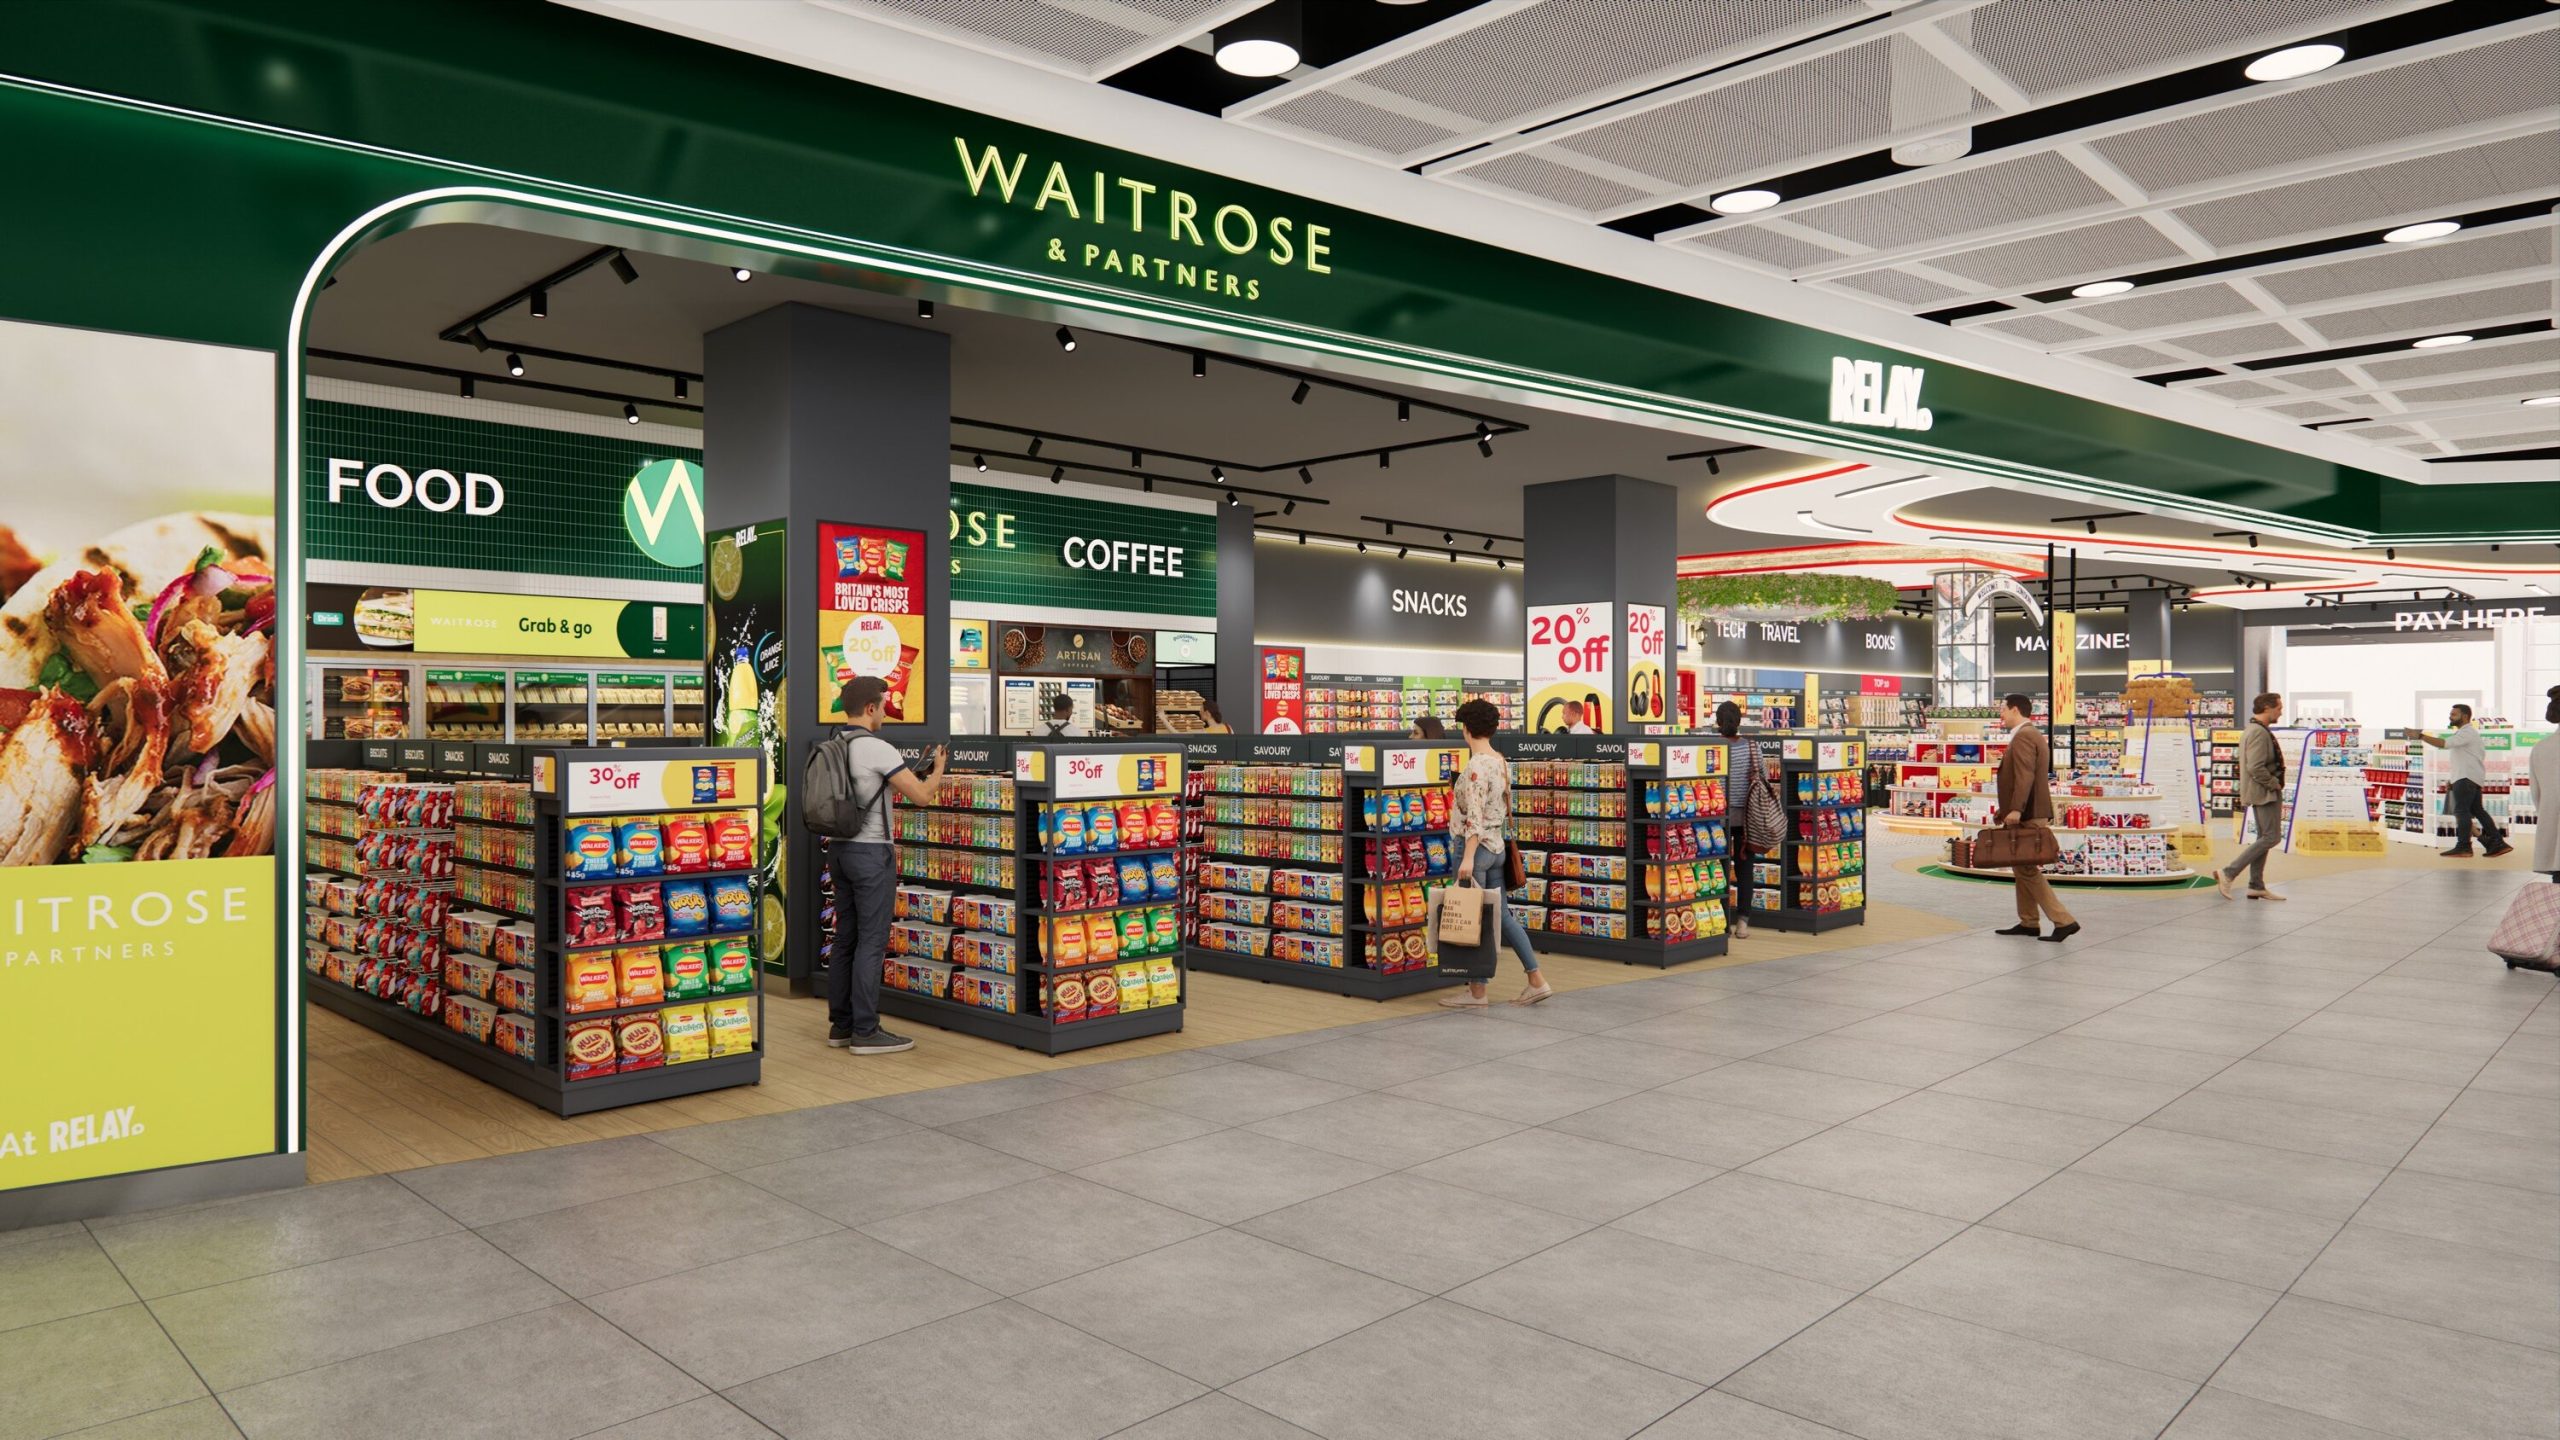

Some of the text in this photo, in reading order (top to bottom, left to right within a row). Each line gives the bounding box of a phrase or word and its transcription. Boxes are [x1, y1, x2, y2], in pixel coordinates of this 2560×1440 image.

[954, 136, 1331, 275] WAITROSE
[1047, 238, 1260, 300] & PARTNERS
[328, 457, 505, 517] FOOD
[1063, 536, 1184, 578] COFFEE
[834, 582, 910, 600] BRITAIN'S MOST
[834, 595, 909, 614] LOVED CRISPS
[1392, 589, 1467, 618] SNACKS
[317, 613, 340, 623] Drink
[430, 616, 498, 629] WAITROSE
[2394, 606, 2546, 631] PAY HERE
[518, 616, 592, 640] Grab & go
[1717, 621, 1747, 639] TECH
[1760, 623, 1800, 643] TRAVEL
[1641, 630, 1664, 655] off
[1865, 633, 1896, 650] BOOKS
[759, 640, 784, 661] ORANGE
[872, 644, 896, 663] off
[1056, 650, 1101, 663] ARTISAN
[1558, 635, 1610, 673] off
[762, 658, 780, 674] JUICE
[1873, 678, 1884, 688] TOP
[1648, 726, 1662, 734] NEW
[370, 748, 388, 758] BISCUITS
[404, 749, 425, 760] BISCUITS
[1188, 744, 1217, 754] SNACKS
[1253, 746, 1291, 756] SAVOURY
[1518, 743, 1557, 752] SAVOURY
[444, 751, 465, 762] SNACKS
[488, 752, 510, 765] SNACKS
[953, 750, 990, 762] SAVOURY
[1403, 757, 1416, 770] off
[1680, 752, 1690, 764] off
[1085, 764, 1104, 779] off
[1970, 768, 1977, 777] 2
[614, 772, 641, 790] off
[1962, 776, 1968, 787] 1
[5, 941, 175, 967] PARTNERS
[720, 958, 747, 966] WALKERS
[629, 968, 657, 977] WALKERS
[676, 963, 703, 971] WALKERS
[580, 974, 609, 983] WALKERS
[577, 1033, 603, 1050] HULA
[626, 1026, 651, 1043] HULA
[632, 1031, 659, 1051] HOOPS
[582, 1039, 611, 1058] HOOPS
[0, 1131, 37, 1158] At
